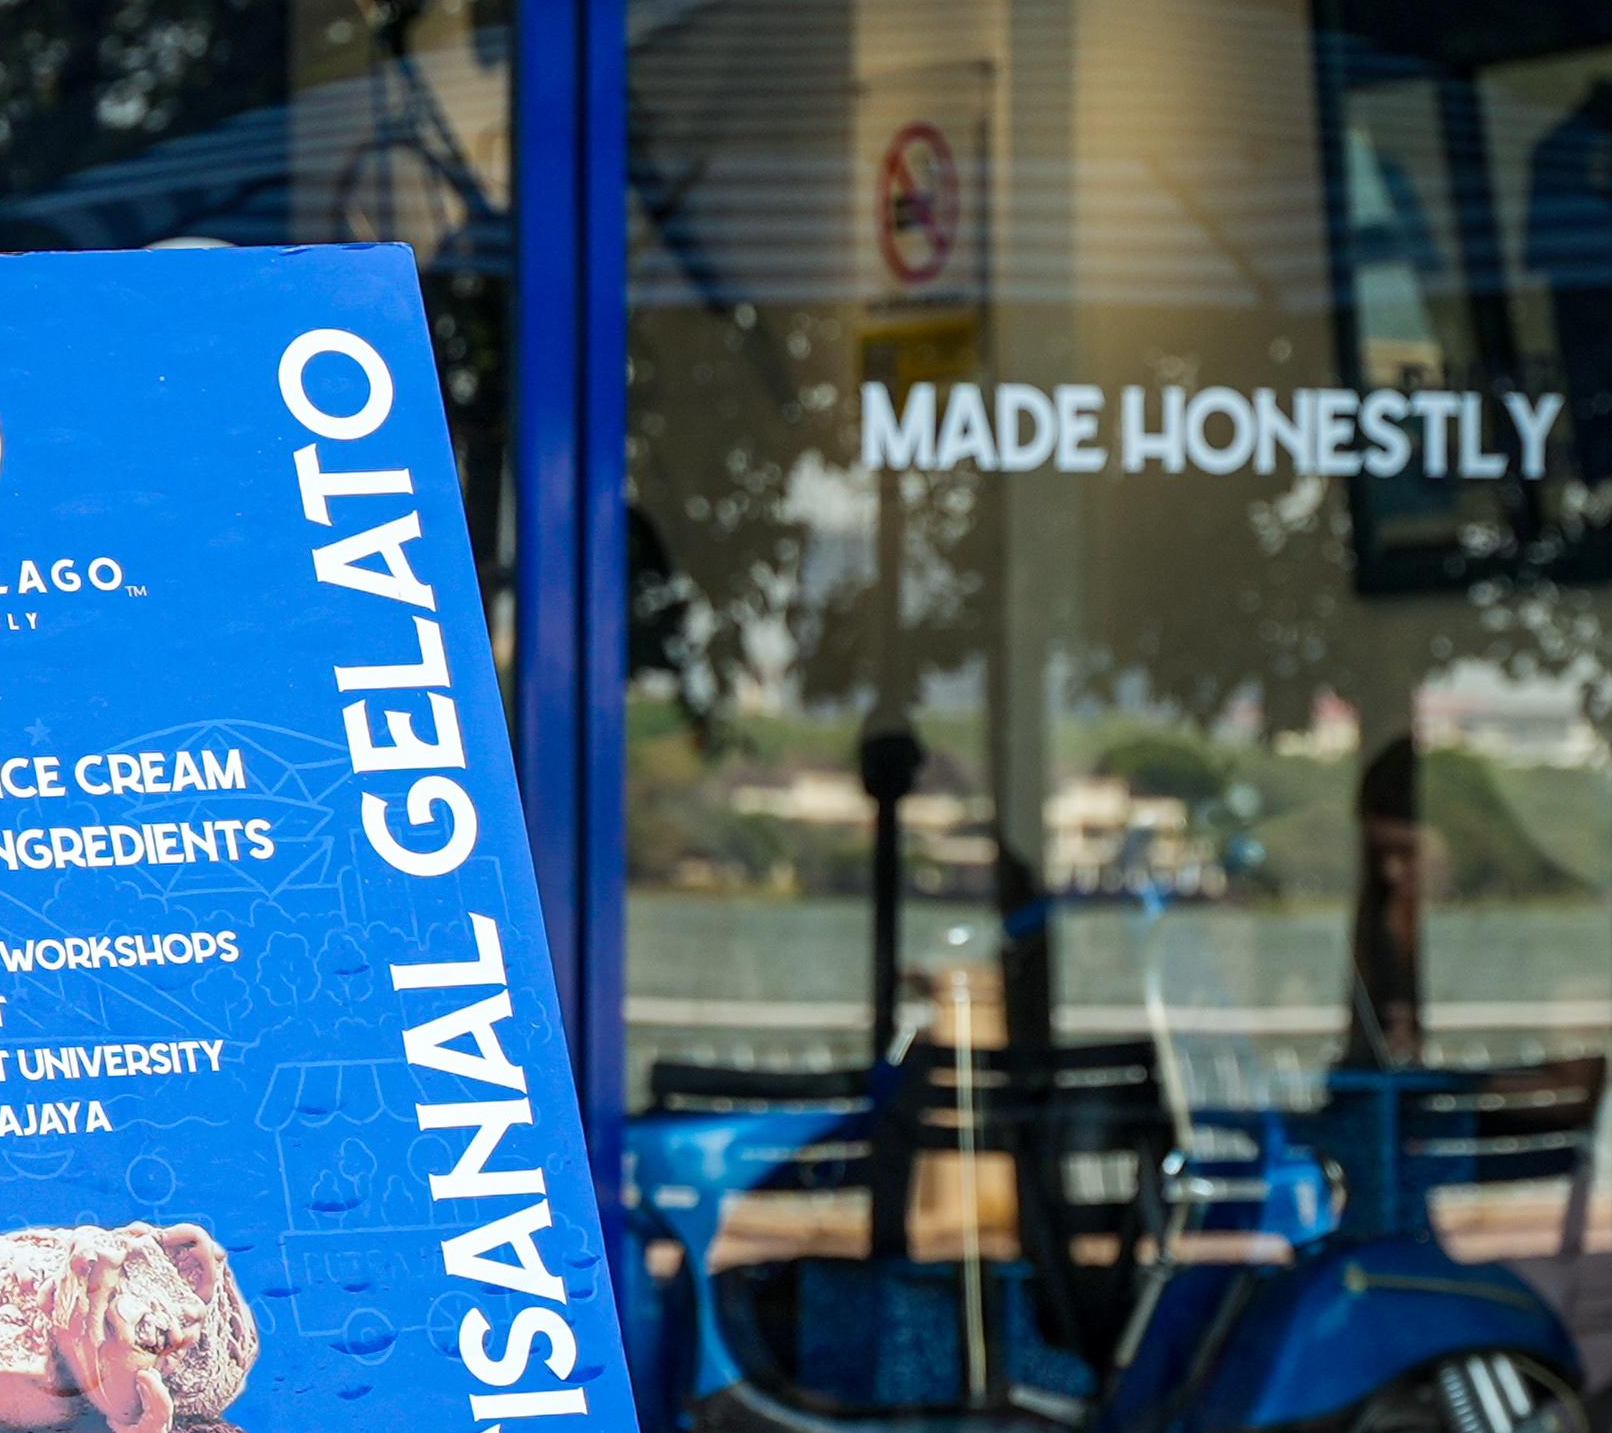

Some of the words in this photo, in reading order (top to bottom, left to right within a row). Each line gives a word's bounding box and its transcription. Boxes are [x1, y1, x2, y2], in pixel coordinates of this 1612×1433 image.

[859, 381, 1109, 474] MADE
[1120, 383, 1565, 481] HONESTLY
[124, 585, 148, 598] TM
[278, 328, 479, 878] GELATO
[75, 748, 247, 795] CREAM
[17, 1039, 225, 1081] UNIVERSITY
